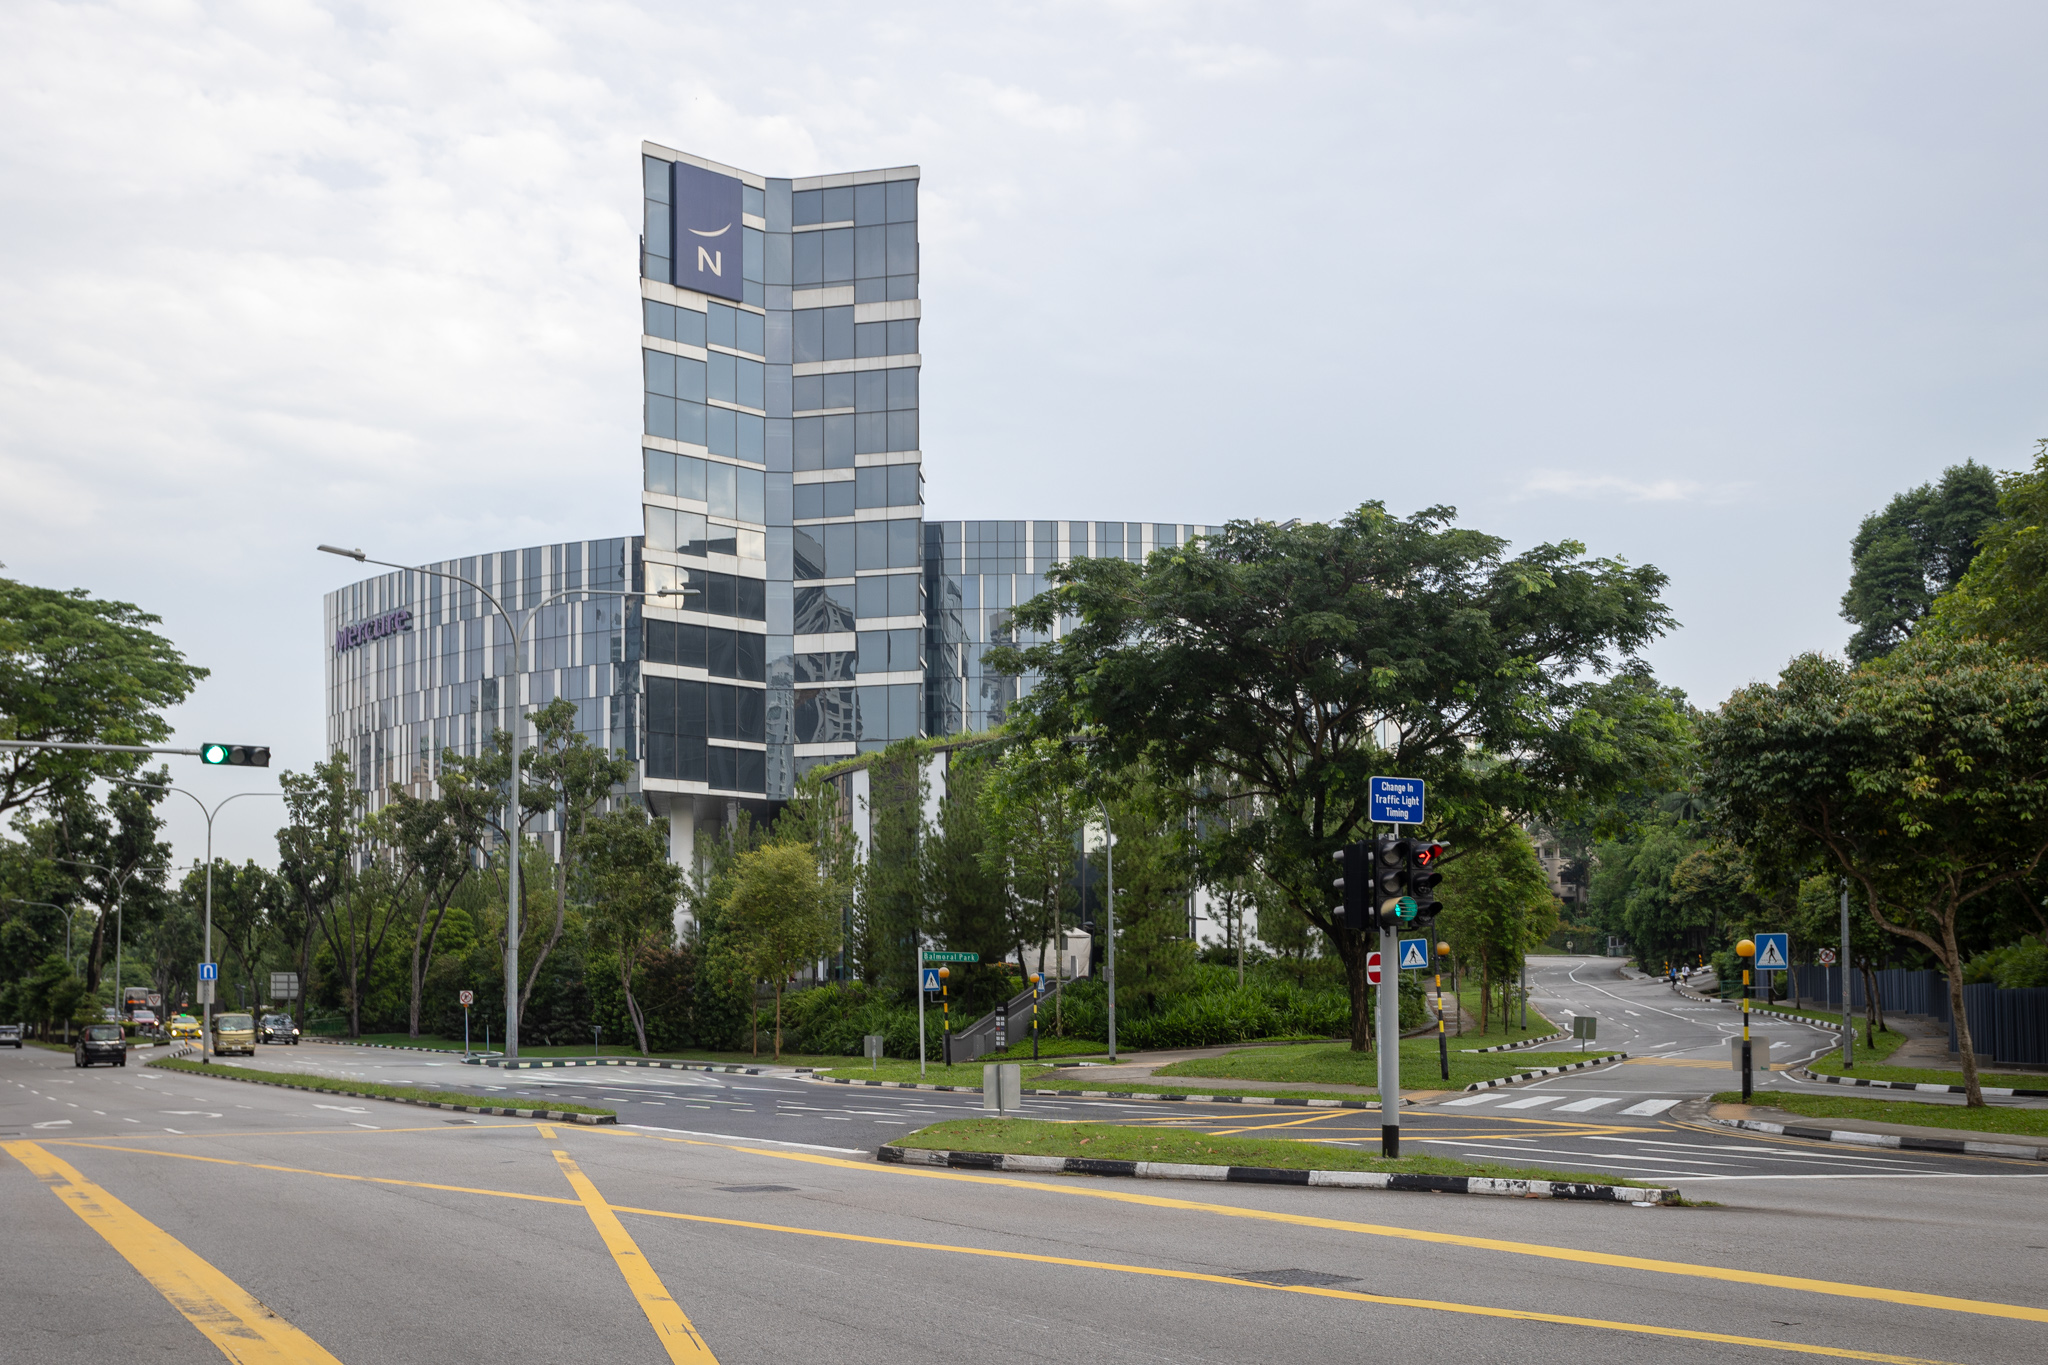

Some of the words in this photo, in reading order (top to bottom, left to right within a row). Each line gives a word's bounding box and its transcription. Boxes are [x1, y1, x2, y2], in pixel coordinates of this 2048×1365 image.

[698, 245, 722, 277] N
[336, 609, 409, 653] Mercure
[1381, 781, 1406, 794] Change
[1407, 782, 1414, 792] In
[1375, 793, 1400, 805] Traffic
[1401, 795, 1420, 808] Light
[1386, 807, 1409, 820] Timing
[924, 952, 957, 960] Balmoral
[959, 953, 975, 961] Park
